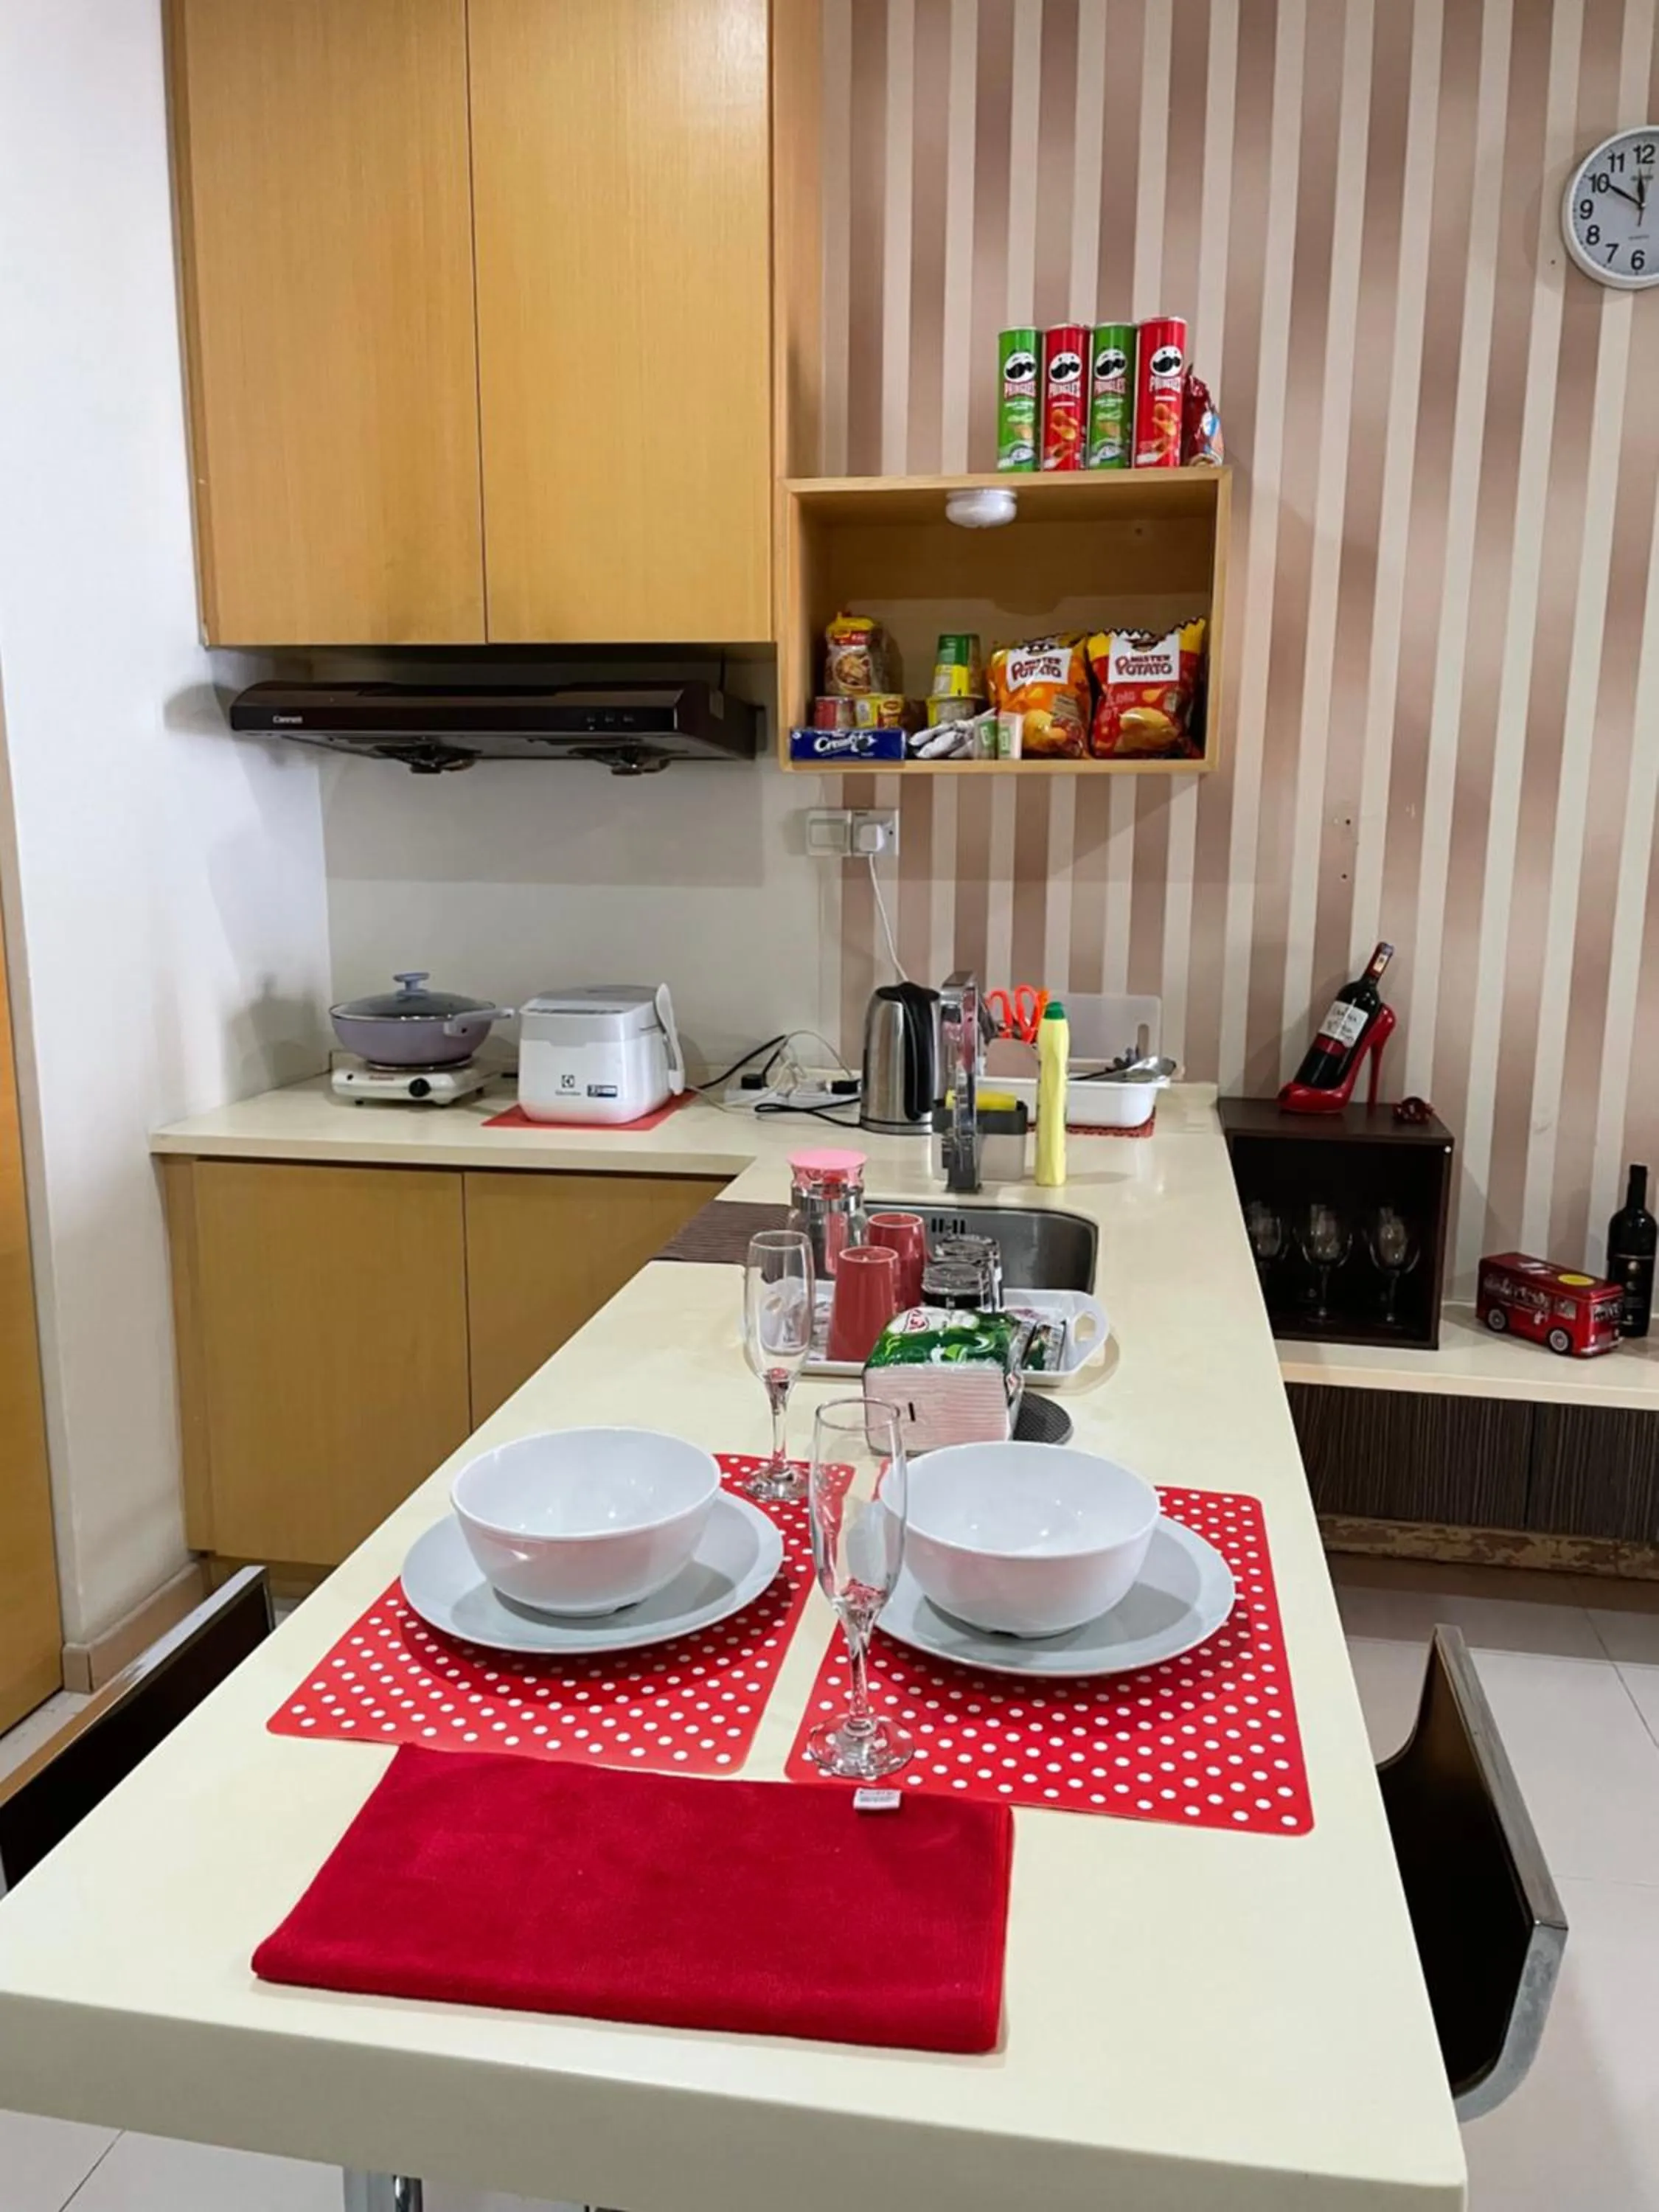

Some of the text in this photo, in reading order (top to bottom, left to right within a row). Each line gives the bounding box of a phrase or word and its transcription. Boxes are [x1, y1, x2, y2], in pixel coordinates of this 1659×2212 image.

[1607, 153, 1625, 173] 11
[1633, 144, 1656, 164] 12
[1588, 173, 1610, 193] 10
[1579, 199, 1594, 220] 9
[1586, 224, 1600, 246] 8
[1605, 243, 1619, 263] 7
[1630, 250, 1645, 271] 6
[1012, 661, 1062, 681] POTATO
[1115, 655, 1172, 675] POTATO
